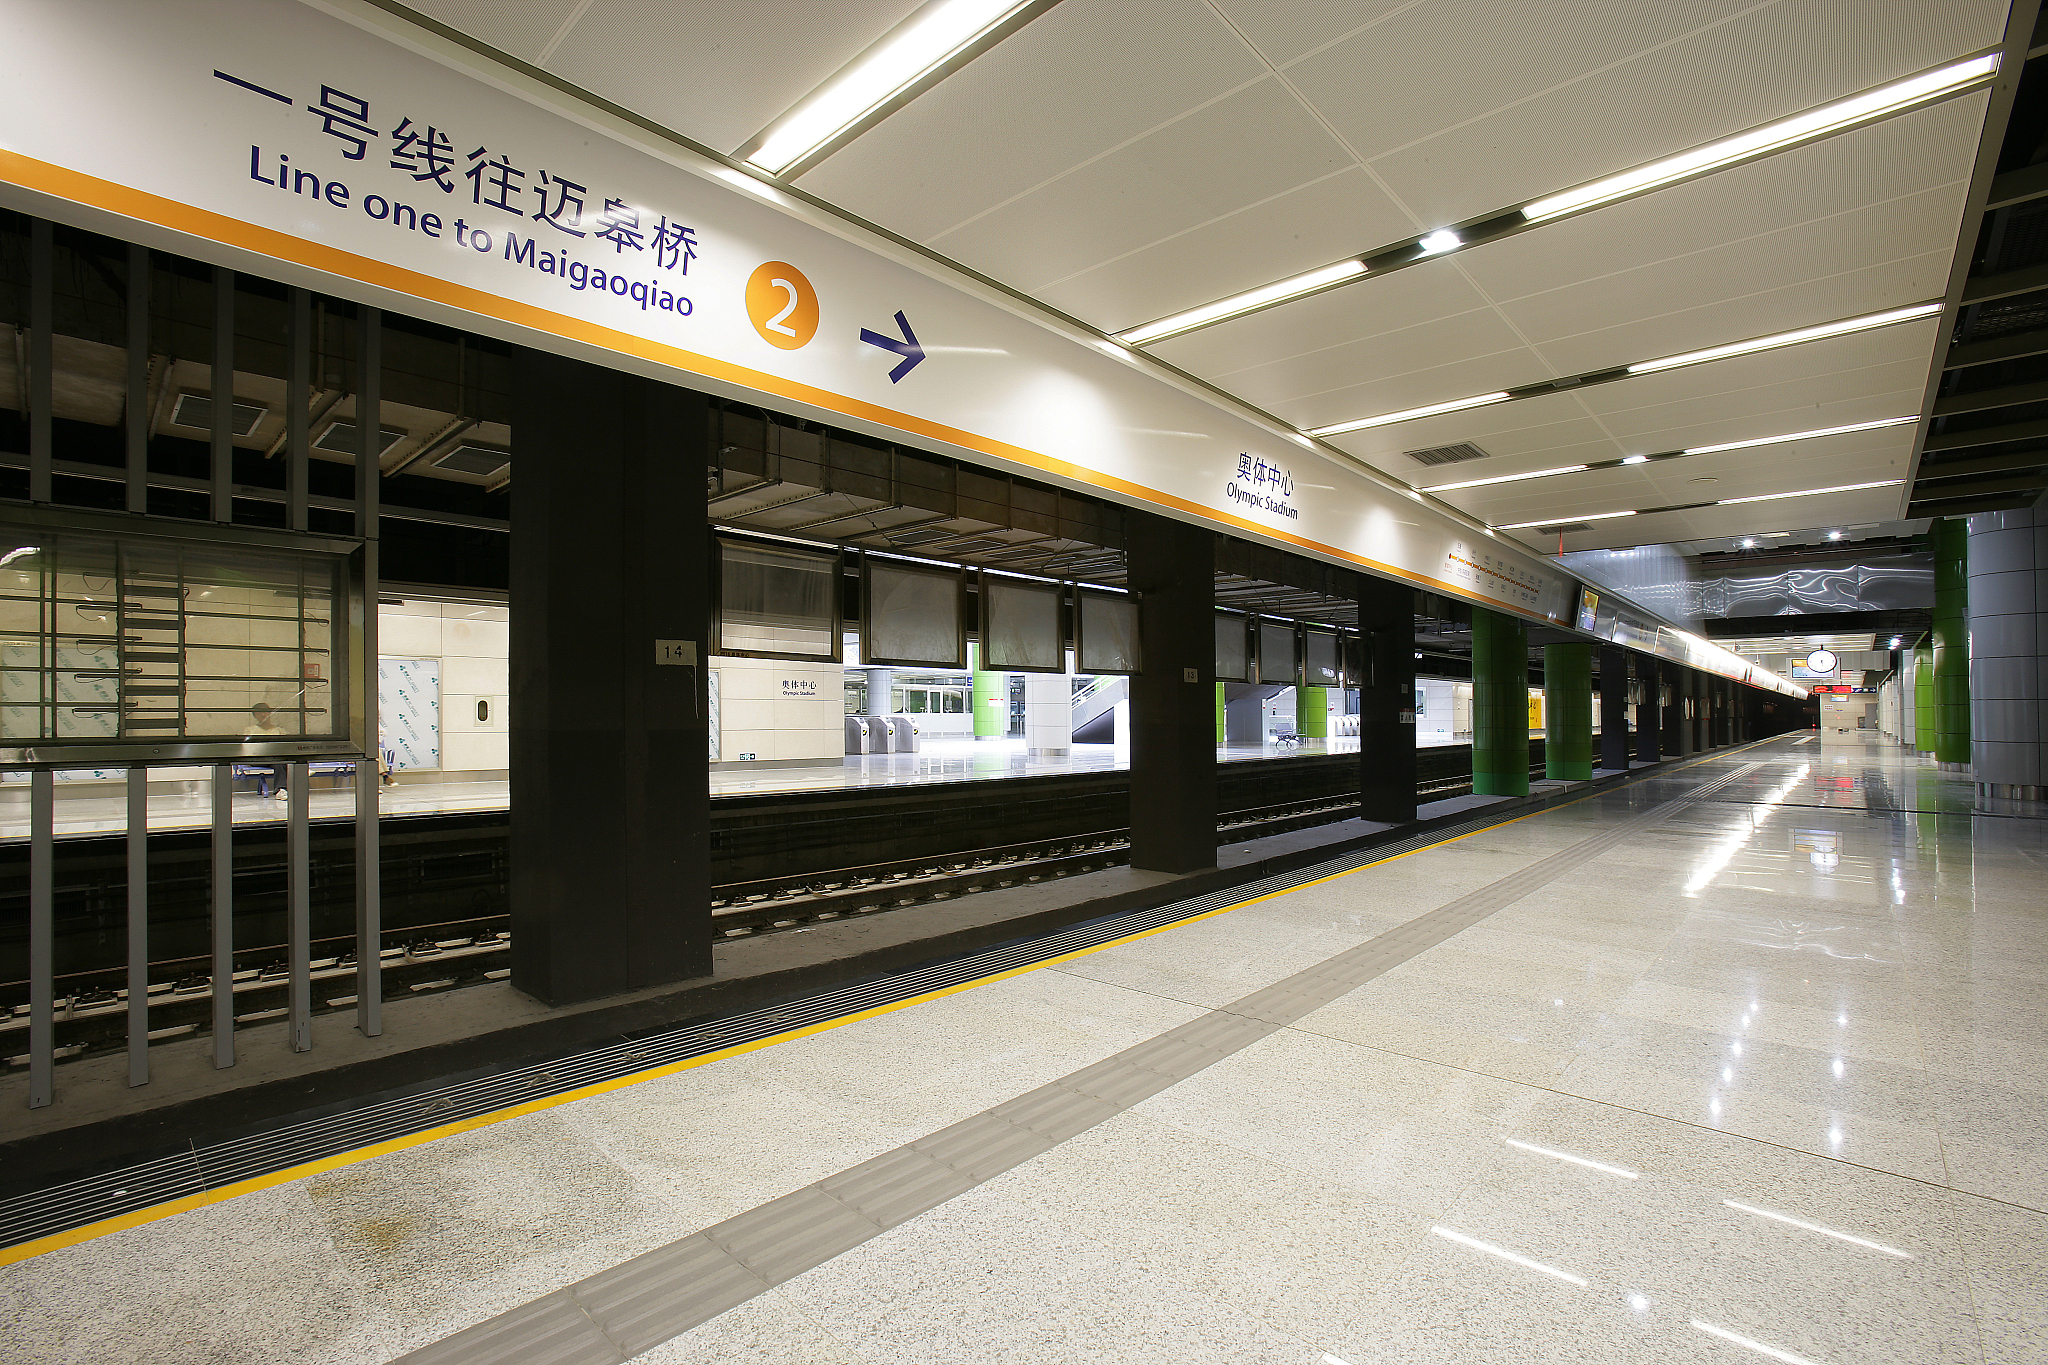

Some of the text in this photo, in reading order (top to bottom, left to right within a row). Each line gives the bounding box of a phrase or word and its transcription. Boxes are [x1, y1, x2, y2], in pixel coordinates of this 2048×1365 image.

[213, 68, 699, 277] 一号线往迈皋桥
[250, 144, 694, 317] Line one to Maigaoqiao
[764, 278, 798, 338] 2
[1236, 451, 1294, 497] 奥体中心
[1226, 481, 1299, 520] Olympic Stadium
[664, 645, 683, 659] 14
[782, 679, 817, 690] 奥体中心
[1187, 671, 1195, 679] 13
